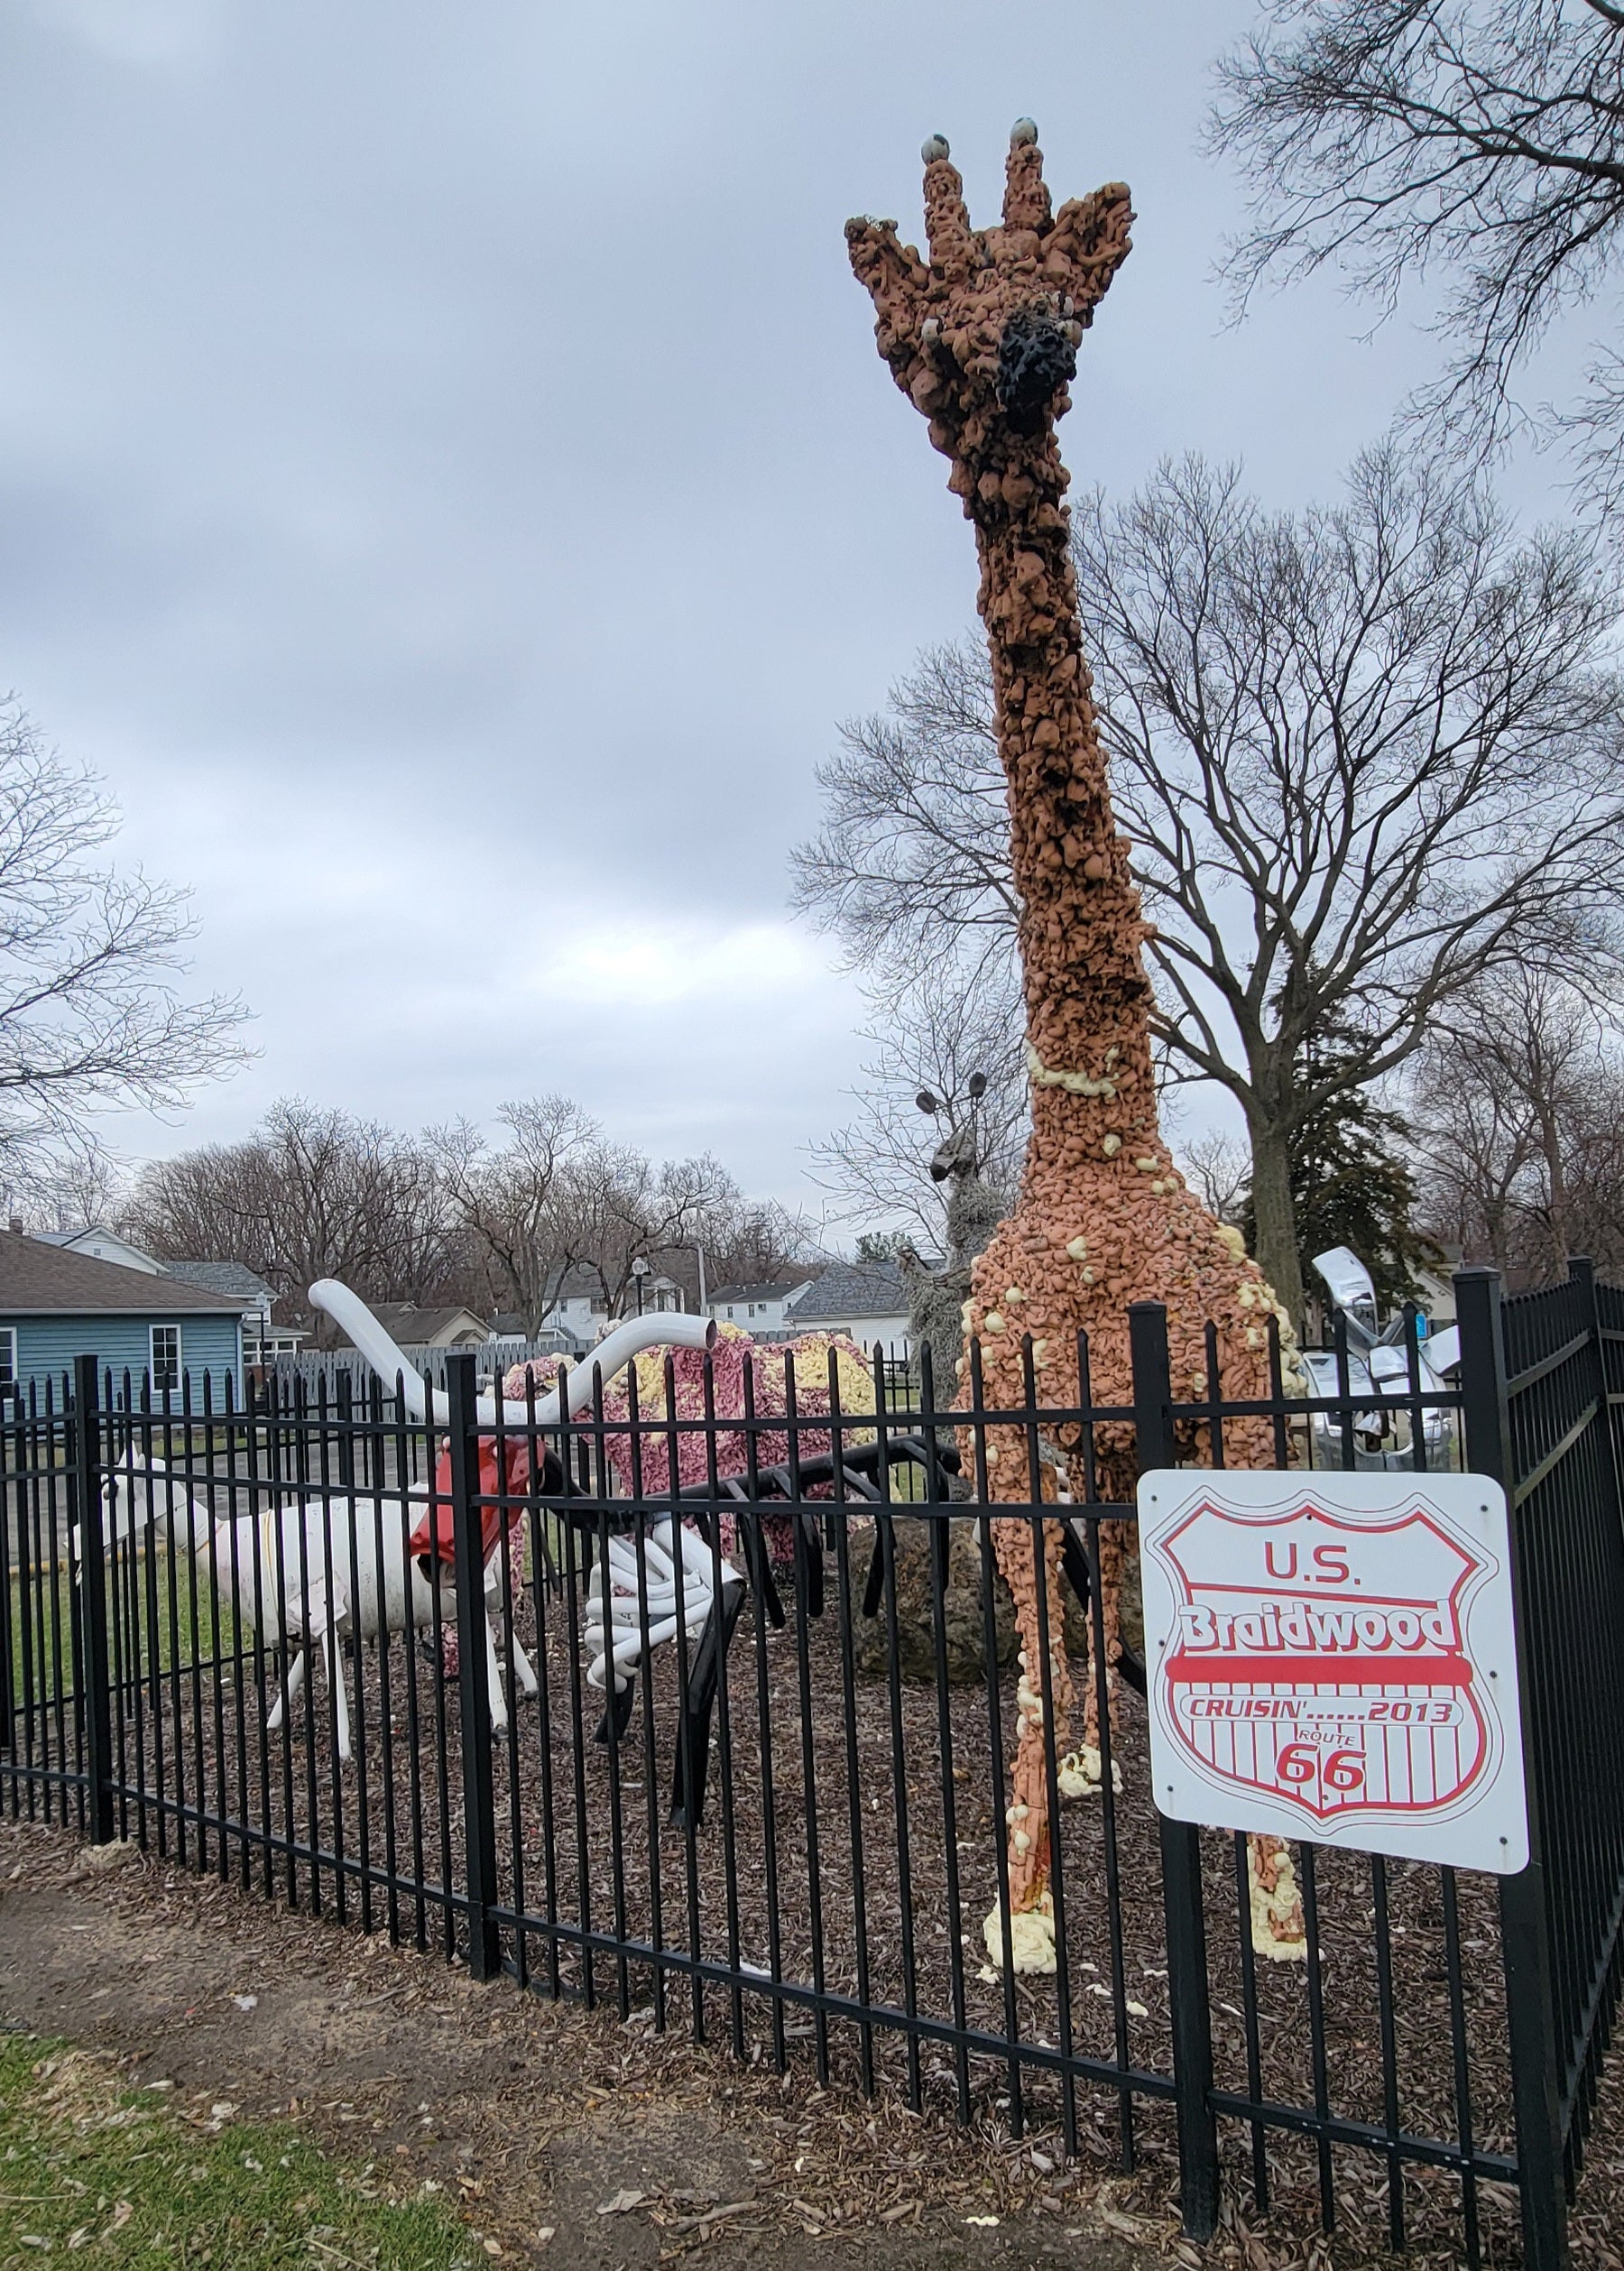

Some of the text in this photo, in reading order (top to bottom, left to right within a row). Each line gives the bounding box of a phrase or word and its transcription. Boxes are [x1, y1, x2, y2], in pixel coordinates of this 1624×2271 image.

[1264, 1542, 1361, 1584] U.S.
[1178, 1598, 1463, 1651] Braidwood
[1298, 1730, 1355, 1746] ROUTE
[1276, 1743, 1367, 1791] 66
